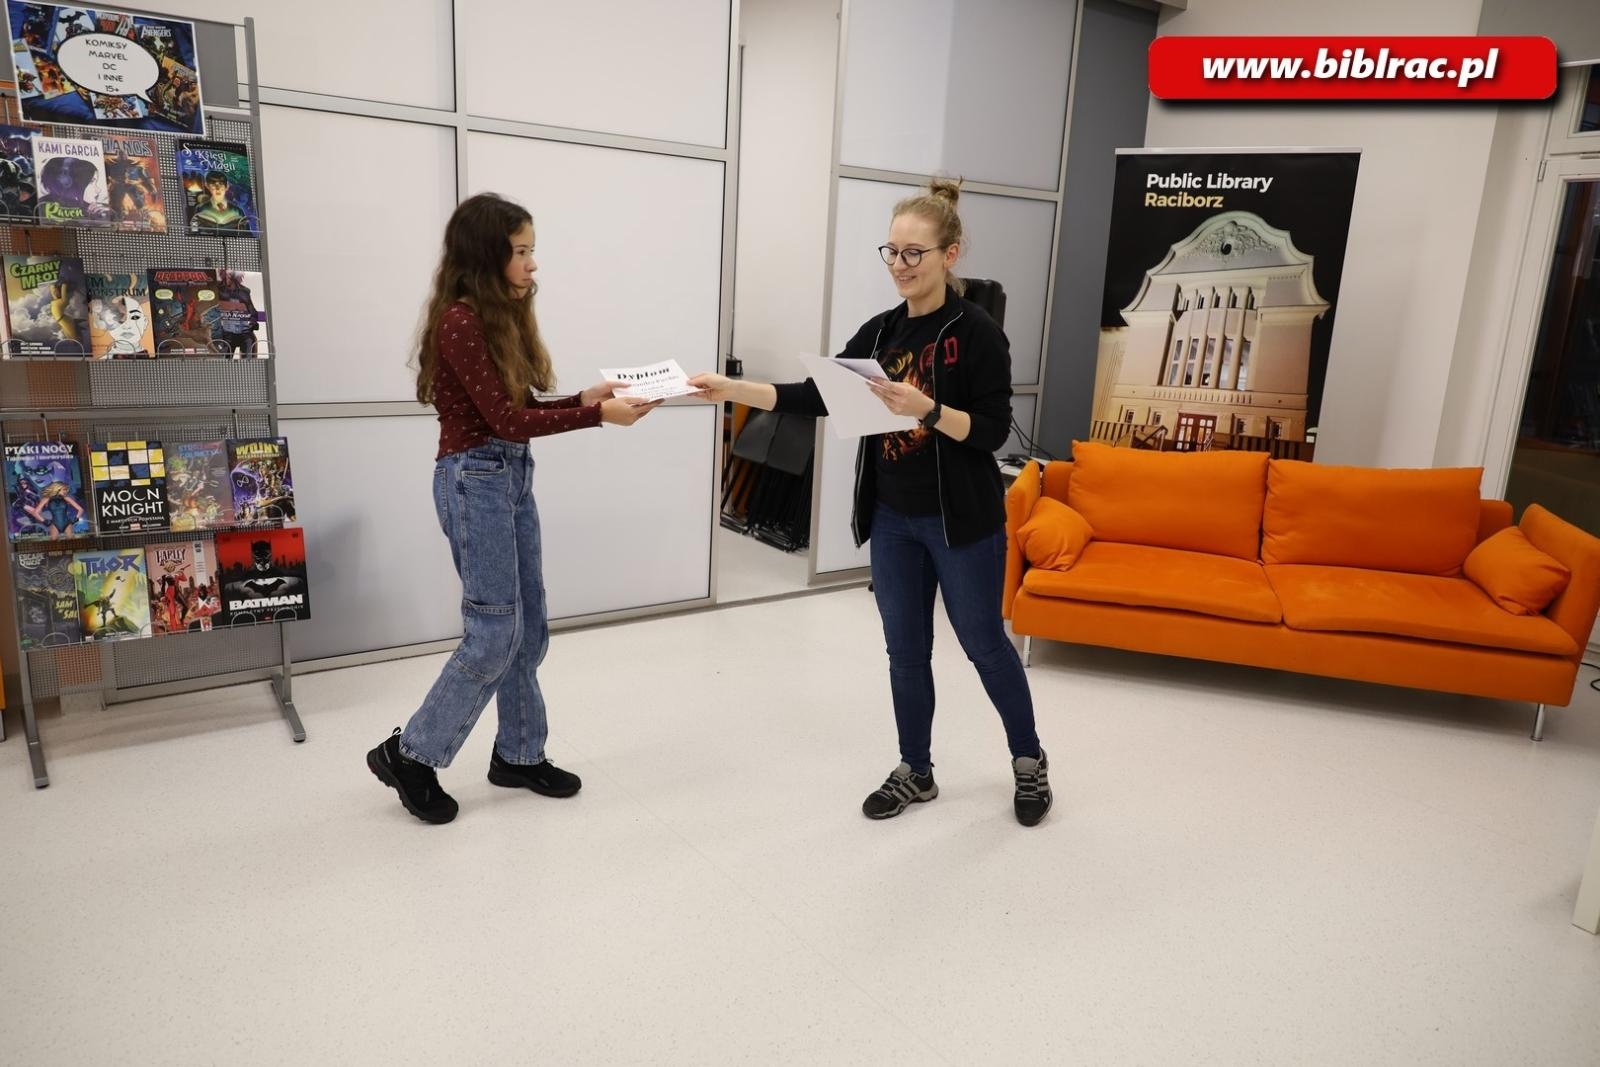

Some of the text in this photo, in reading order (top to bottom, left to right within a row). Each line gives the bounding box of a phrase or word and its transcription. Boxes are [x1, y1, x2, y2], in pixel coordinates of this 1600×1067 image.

[85, 39, 128, 50] KOMIKSY
[88, 50, 128, 61] MARVEL
[102, 63, 117, 71] DC
[103, 74, 124, 83] INNE
[38, 142, 100, 157] KAMI GARCIA
[102, 140, 153, 156] HANOS
[1146, 172, 1274, 193] Public Library
[1144, 191, 1224, 208] Raciborz
[45, 202, 84, 221] Raven
[617, 367, 670, 381] Dyplom
[5, 444, 73, 455] PTAKI NOCY
[102, 488, 160, 503] MOON
[101, 501, 164, 517] KNIGHT
[79, 555, 140, 577] THOR
[229, 594, 304, 611] BATMAN
